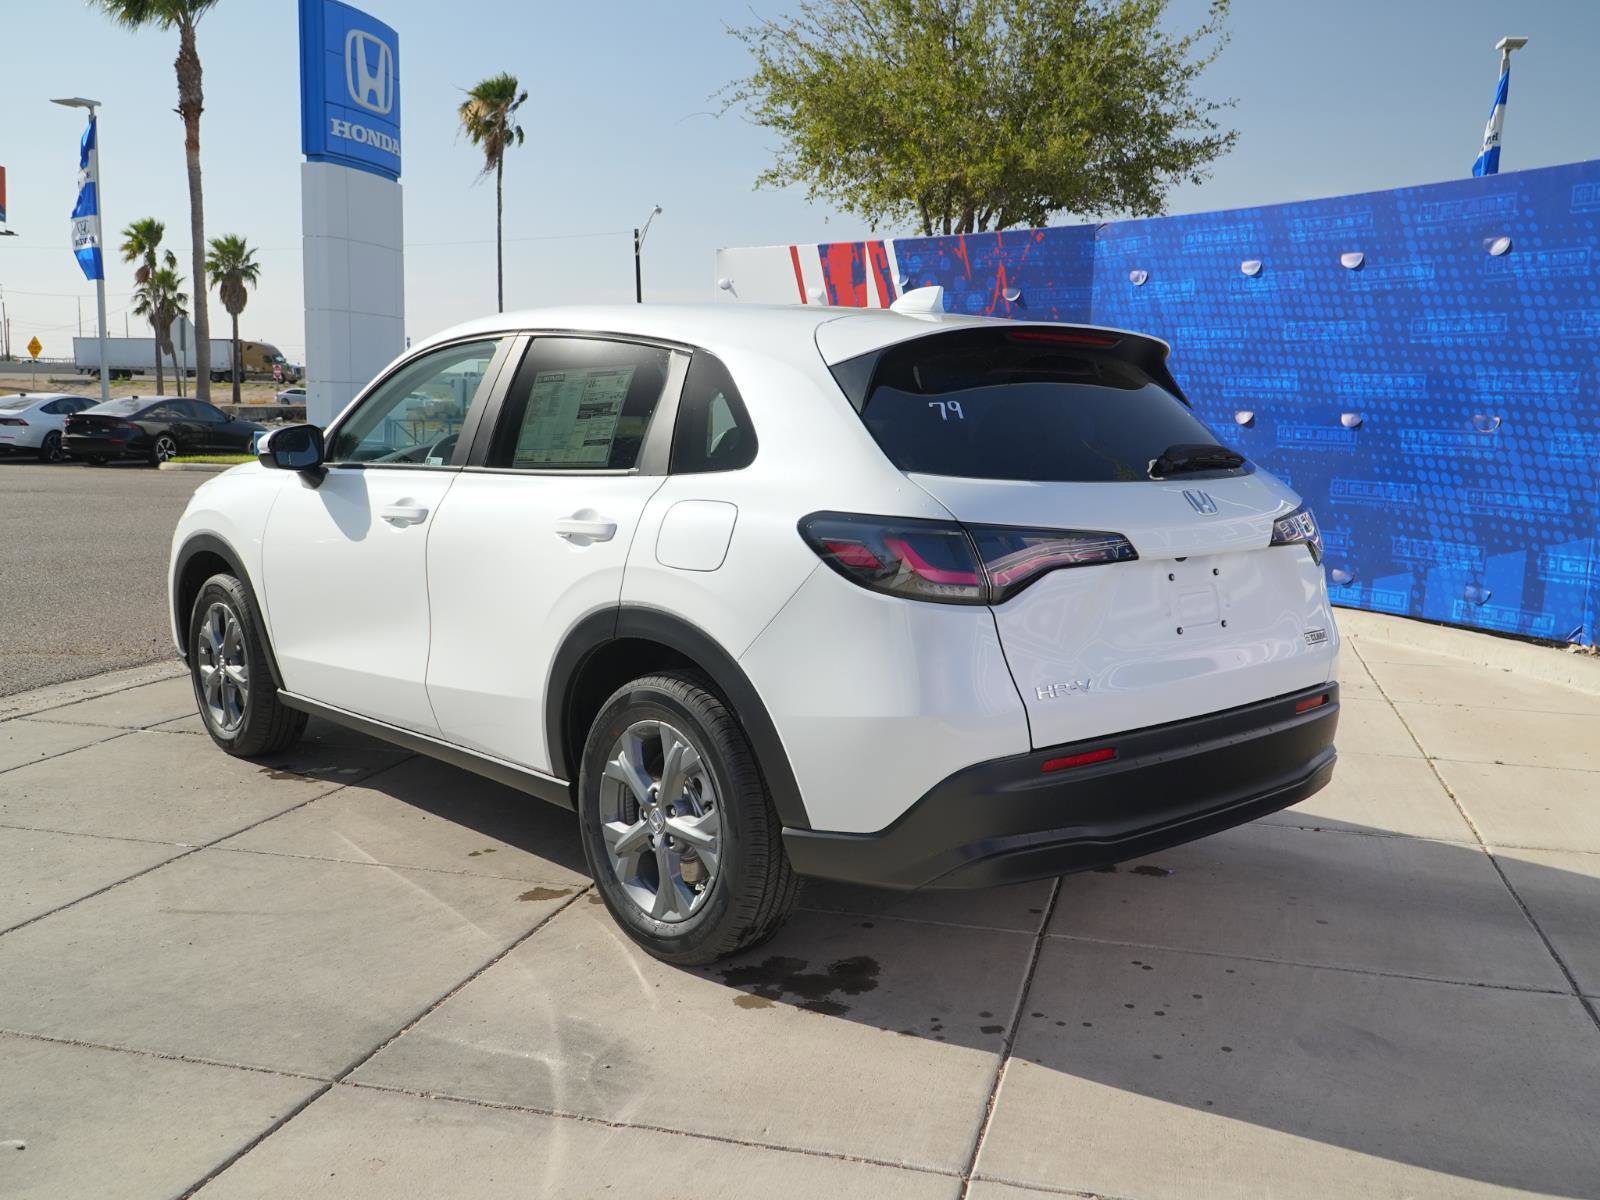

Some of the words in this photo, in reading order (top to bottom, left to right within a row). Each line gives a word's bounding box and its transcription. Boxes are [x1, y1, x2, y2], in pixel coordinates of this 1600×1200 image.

[330, 118, 401, 157] HONDA
[928, 400, 964, 420] 79
[1035, 679, 1091, 701] HR-V
